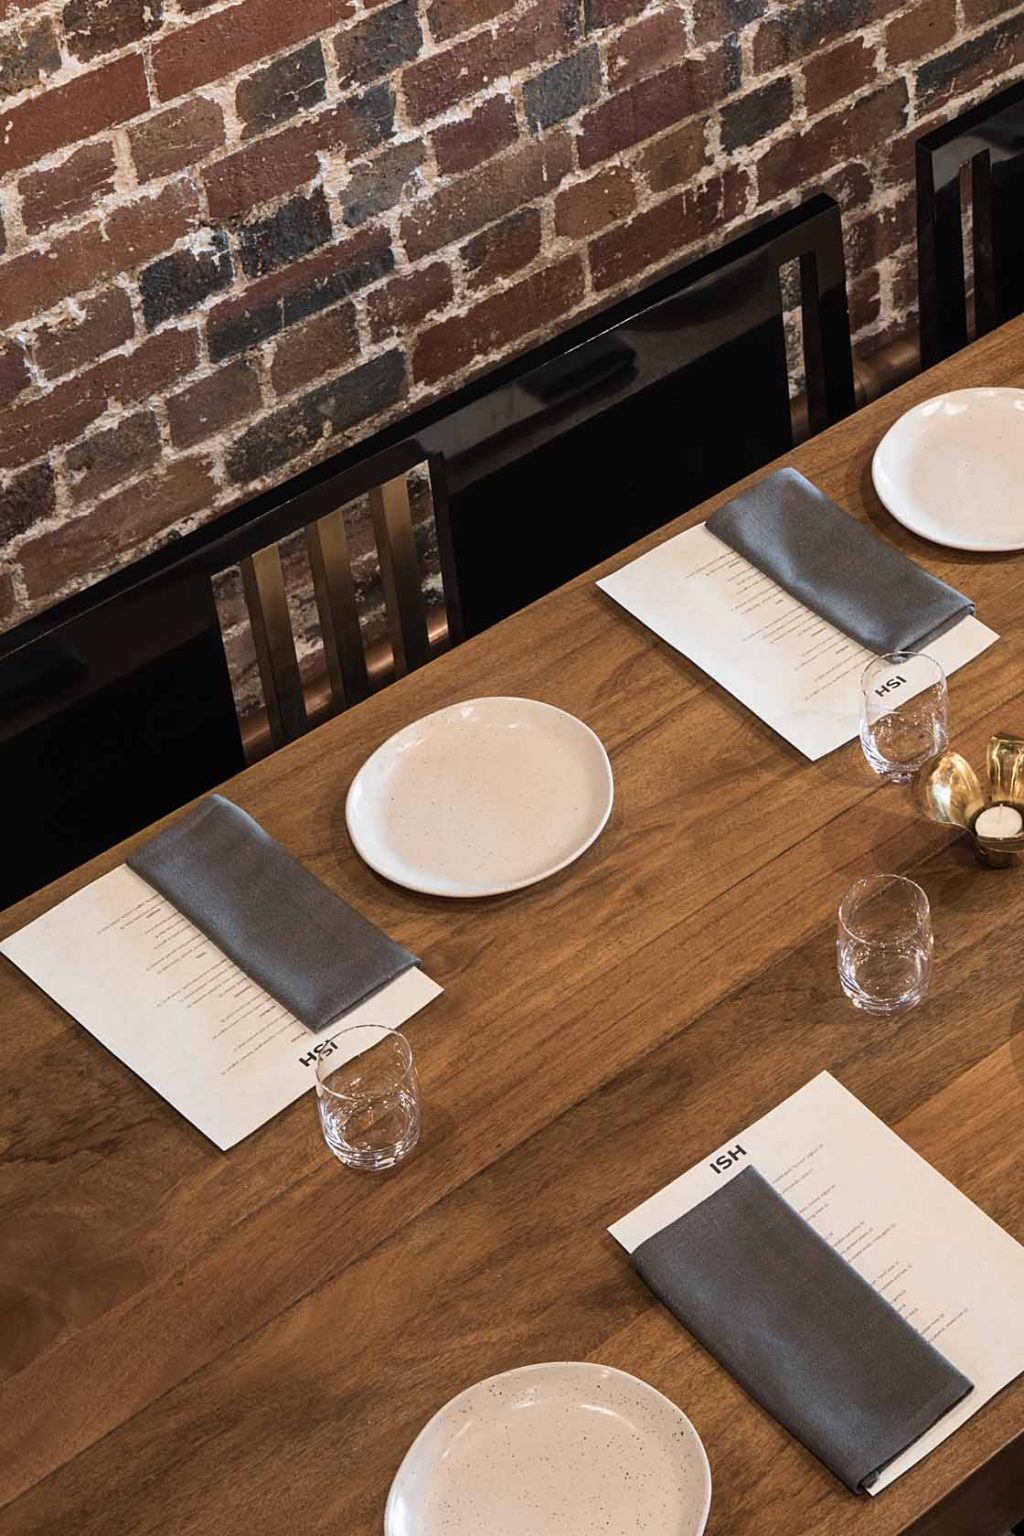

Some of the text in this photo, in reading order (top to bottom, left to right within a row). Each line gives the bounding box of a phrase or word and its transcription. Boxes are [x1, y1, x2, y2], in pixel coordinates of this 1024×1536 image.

[875, 675, 907, 697] ISH
[298, 1039, 339, 1068] ISH
[709, 1144, 747, 1174] ISH
